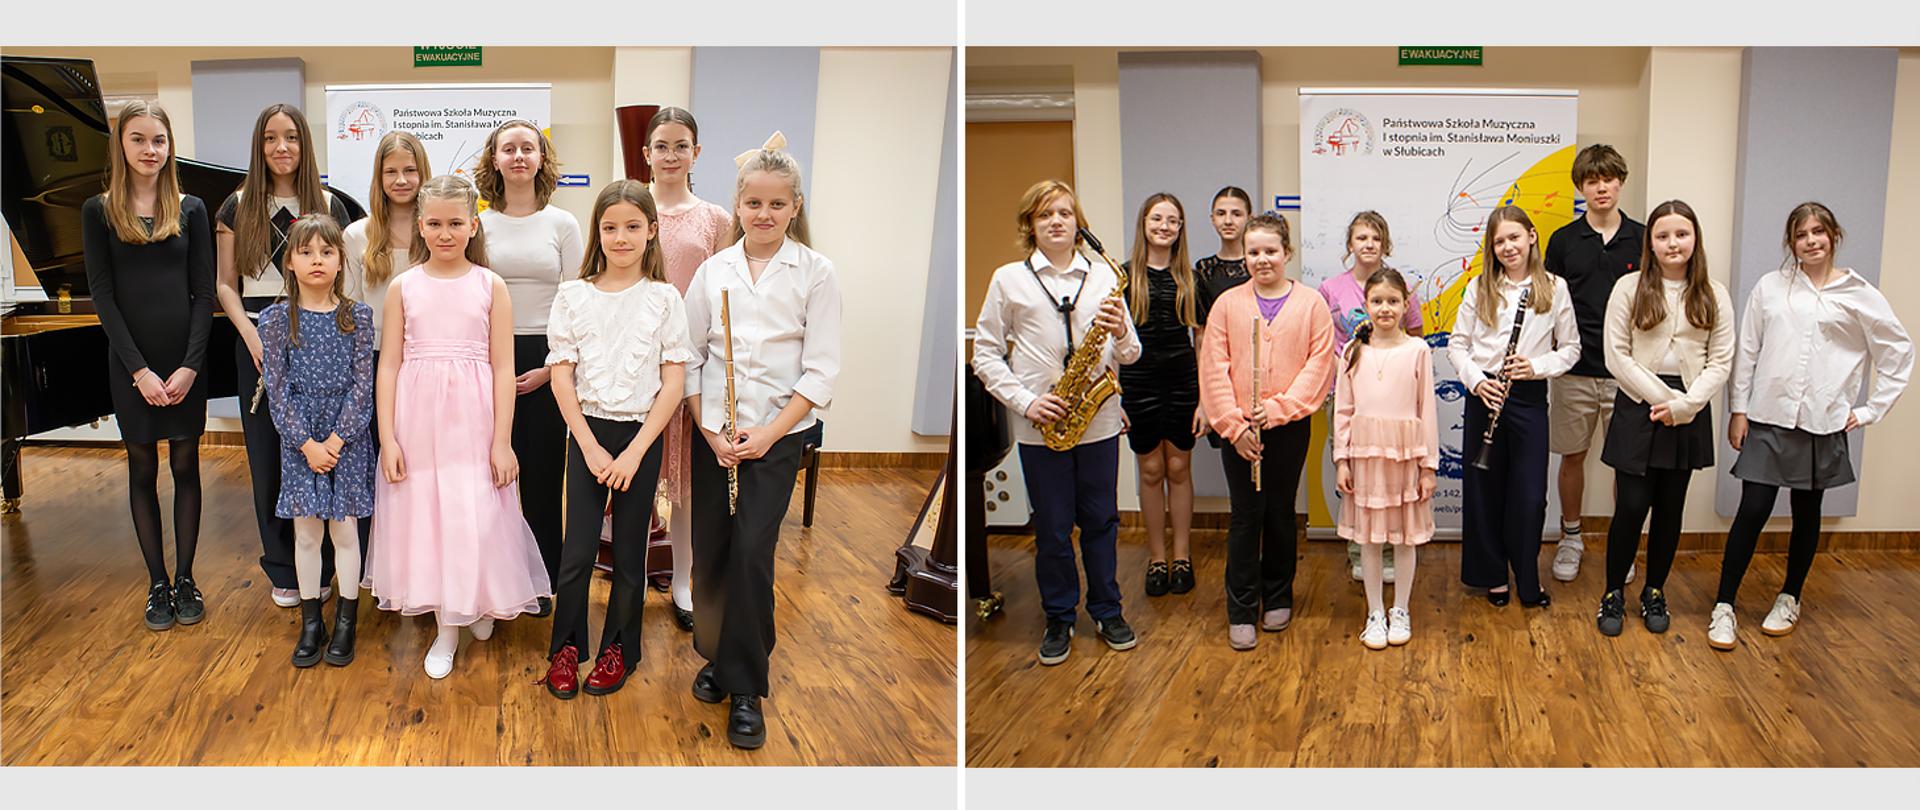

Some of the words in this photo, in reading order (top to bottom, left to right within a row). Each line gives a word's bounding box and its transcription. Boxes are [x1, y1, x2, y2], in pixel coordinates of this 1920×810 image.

[415, 53, 480, 62] EWAKUACYJNE
[1401, 49, 1480, 59] EWAKUACYJNE
[393, 108, 442, 117] Państwowa
[443, 108, 472, 117] Szkoła
[474, 108, 517, 118] Muzyczna
[398, 120, 429, 130] stopnia
[431, 120, 444, 129] im.
[445, 120, 492, 129] Stanisława
[1382, 118, 1443, 129] Państwowa
[1445, 118, 1480, 129] Szkoła
[1482, 119, 1535, 131] Muzyczna
[1388, 132, 1428, 144] stopnia
[1429, 132, 1445, 142] im.
[1447, 132, 1504, 143] Stanisława
[1506, 134, 1561, 144] Moniuszki
[1383, 148, 1392, 156] w
[1394, 145, 1445, 157] Słubicach
